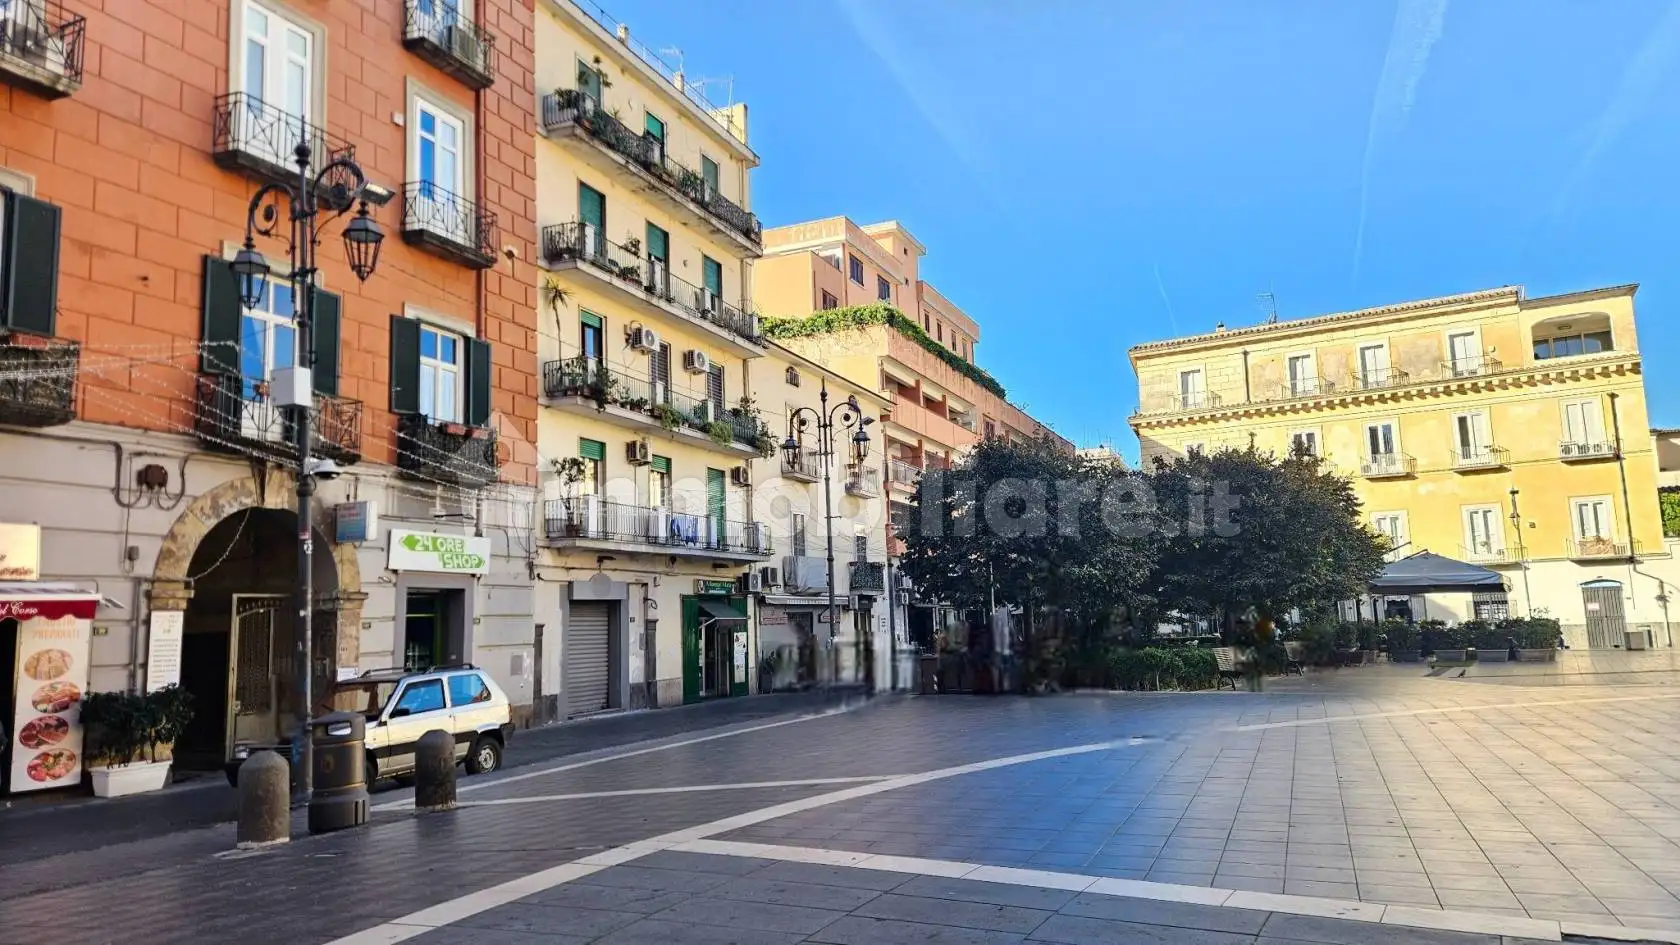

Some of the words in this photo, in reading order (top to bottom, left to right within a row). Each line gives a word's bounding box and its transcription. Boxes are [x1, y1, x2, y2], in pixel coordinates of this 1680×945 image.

[414, 535, 433, 551] 24
[436, 537, 464, 552] ORE
[443, 553, 479, 568] SHOP
